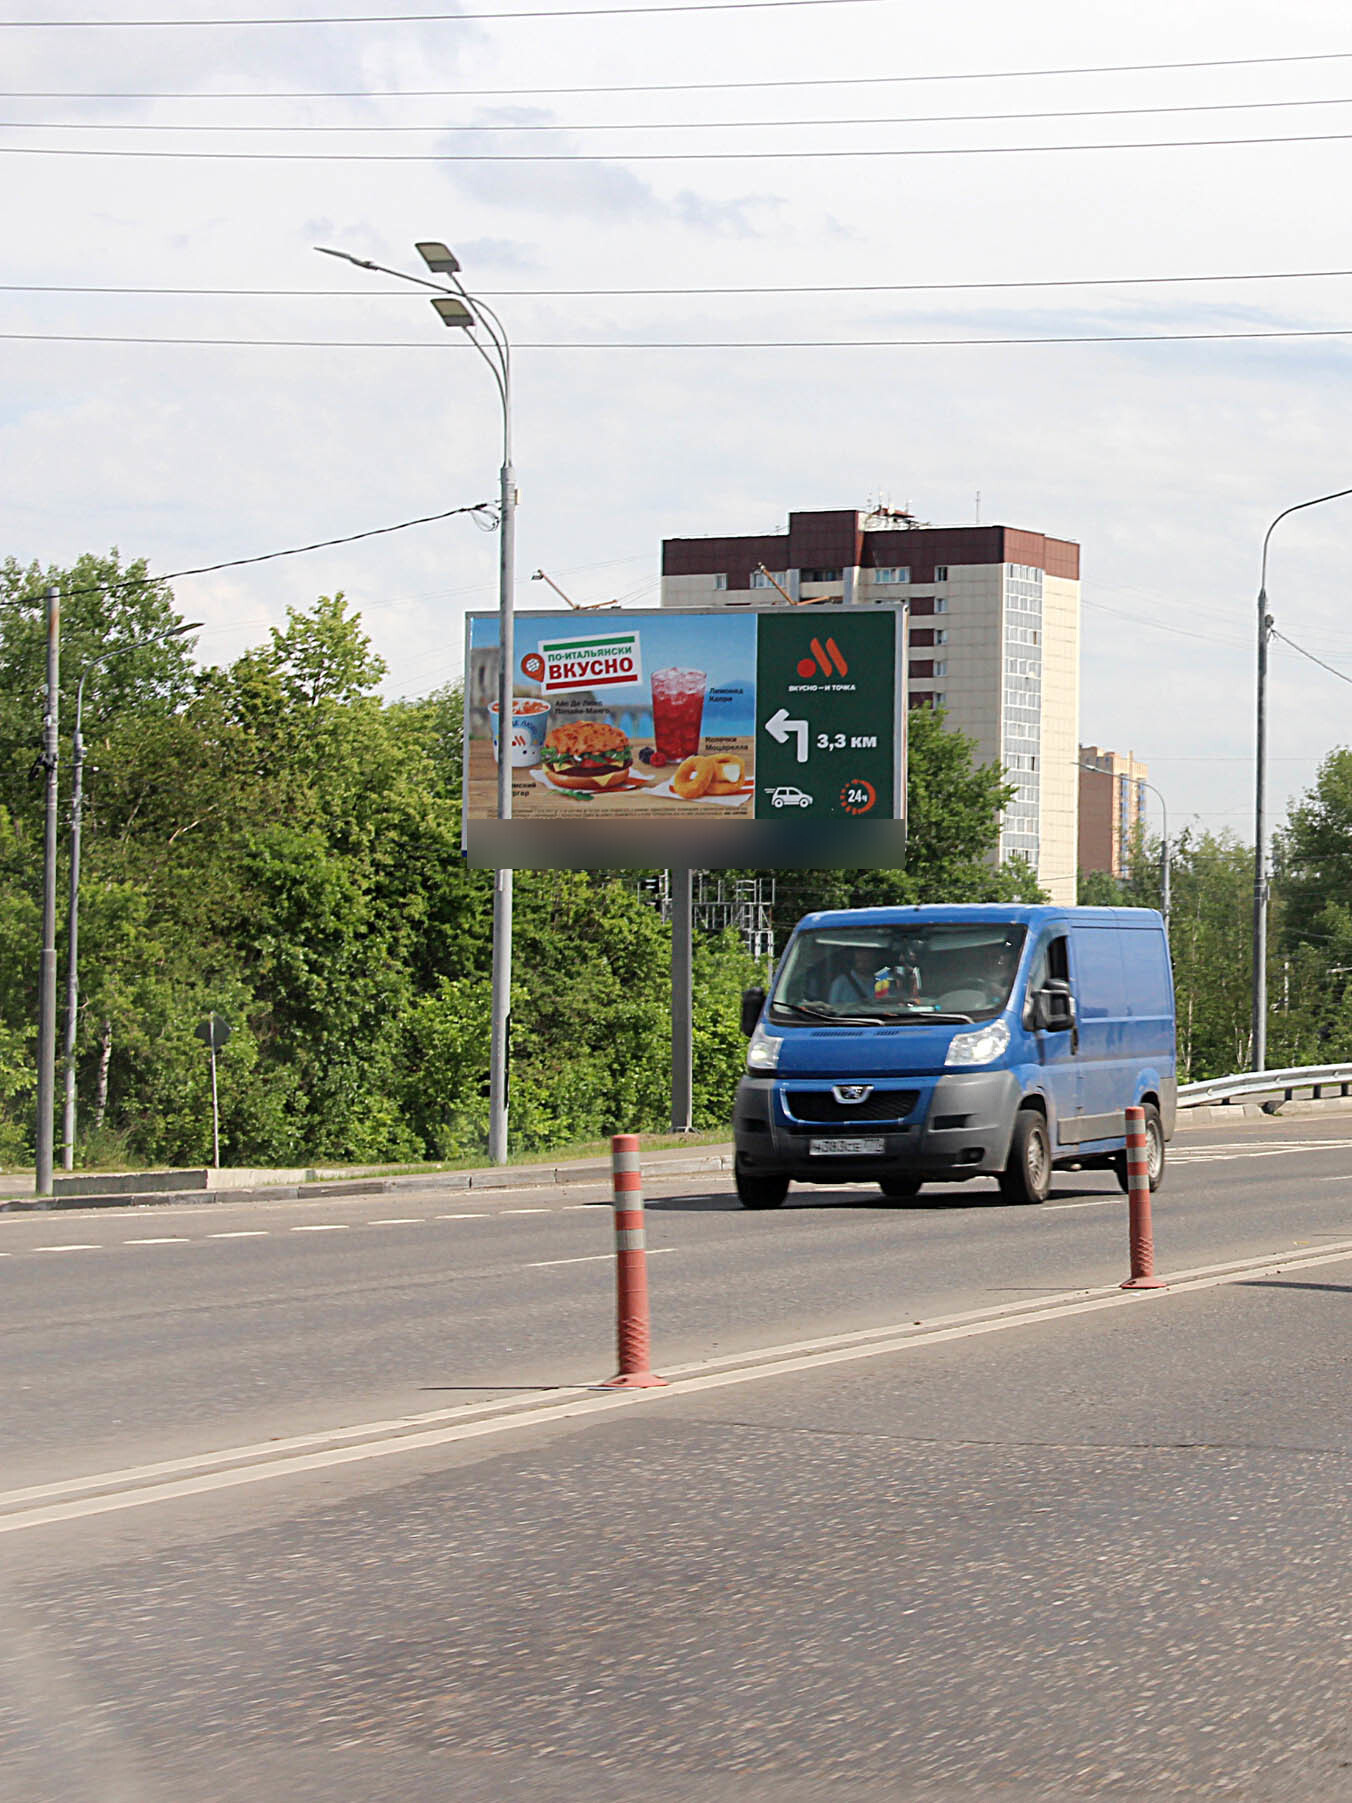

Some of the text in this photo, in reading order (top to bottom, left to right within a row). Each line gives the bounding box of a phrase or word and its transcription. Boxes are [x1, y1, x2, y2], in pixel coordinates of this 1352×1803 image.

[548, 646, 632, 662] ПО-ИТАЛЬЯНСКИ
[549, 657, 633, 680] ВКУСНО
[832, 684, 856, 692] ТОЧКА
[817, 733, 846, 751] 3,3
